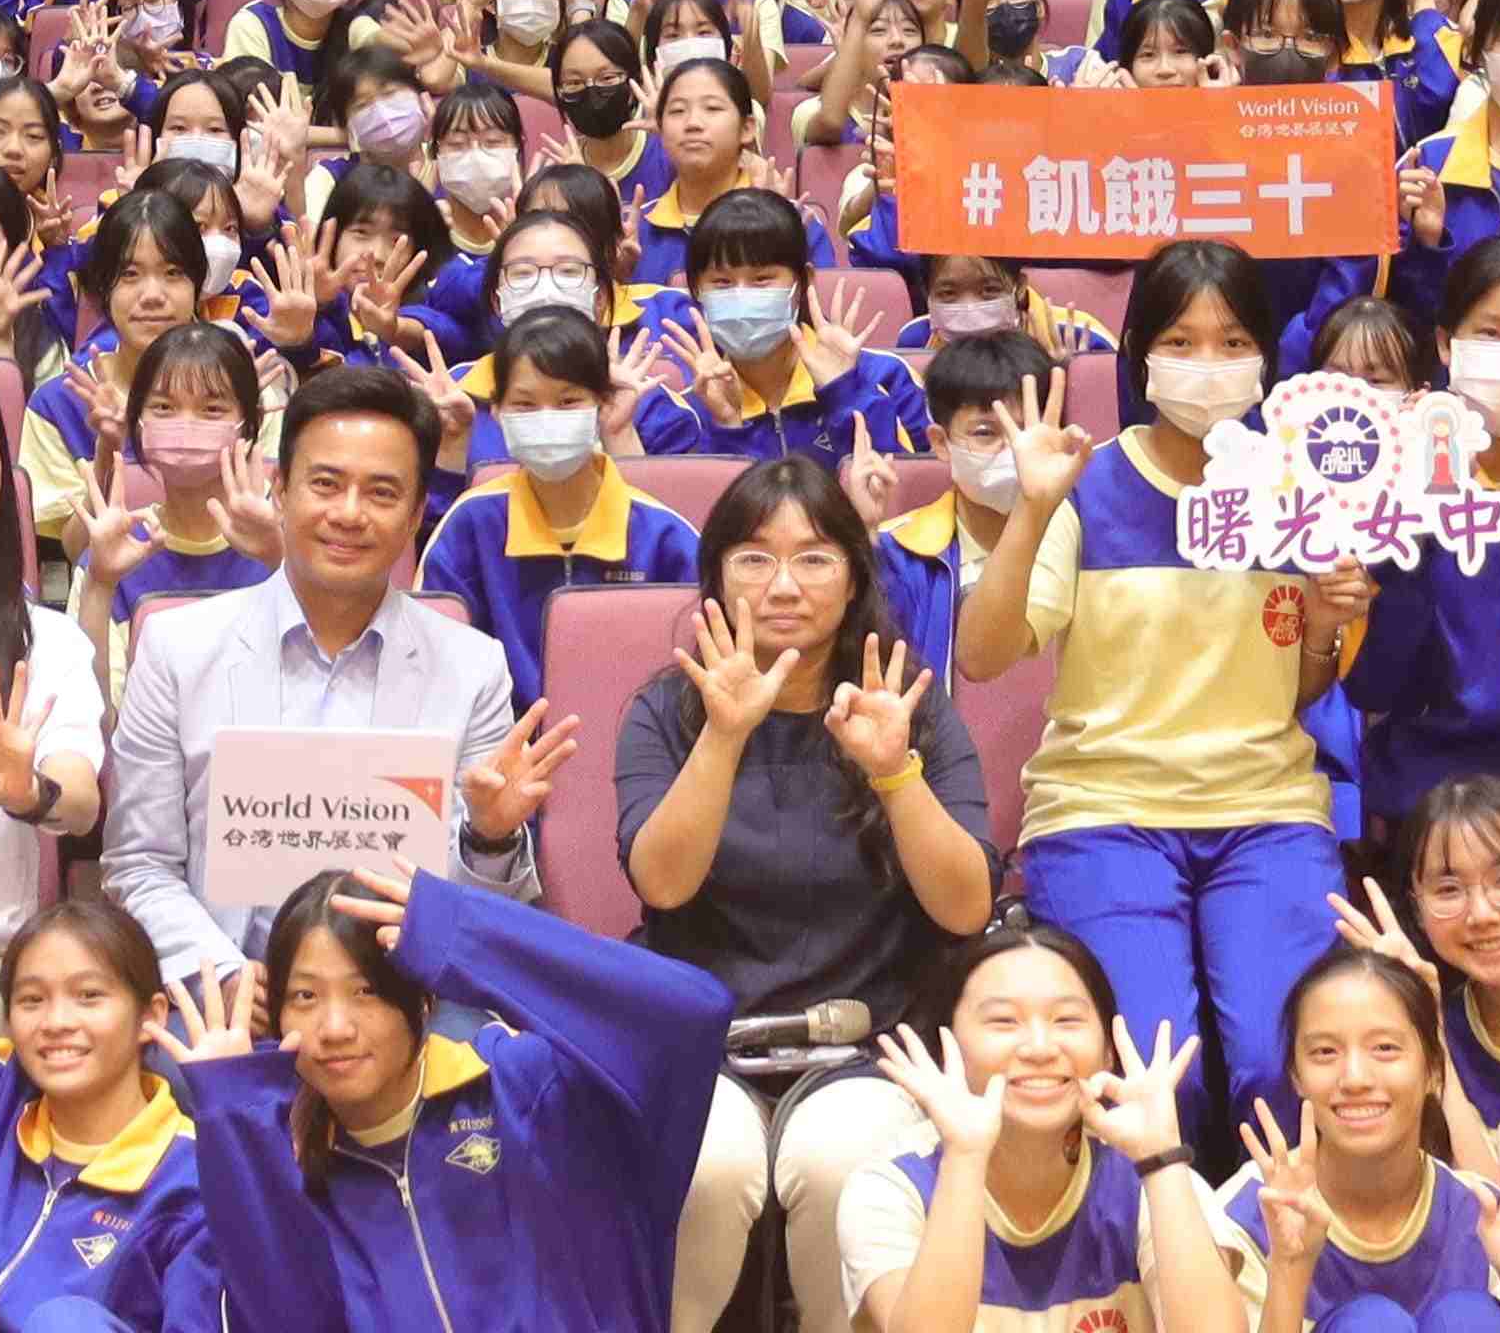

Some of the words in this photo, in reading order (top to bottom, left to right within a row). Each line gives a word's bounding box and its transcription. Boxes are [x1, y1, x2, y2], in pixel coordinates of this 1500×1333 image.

[1237, 99, 1296, 119] World
[1301, 97, 1361, 118] Vision
[1022, 153, 1333, 237] 飢餓三十
[223, 794, 312, 819] World
[321, 797, 410, 821] Vision
